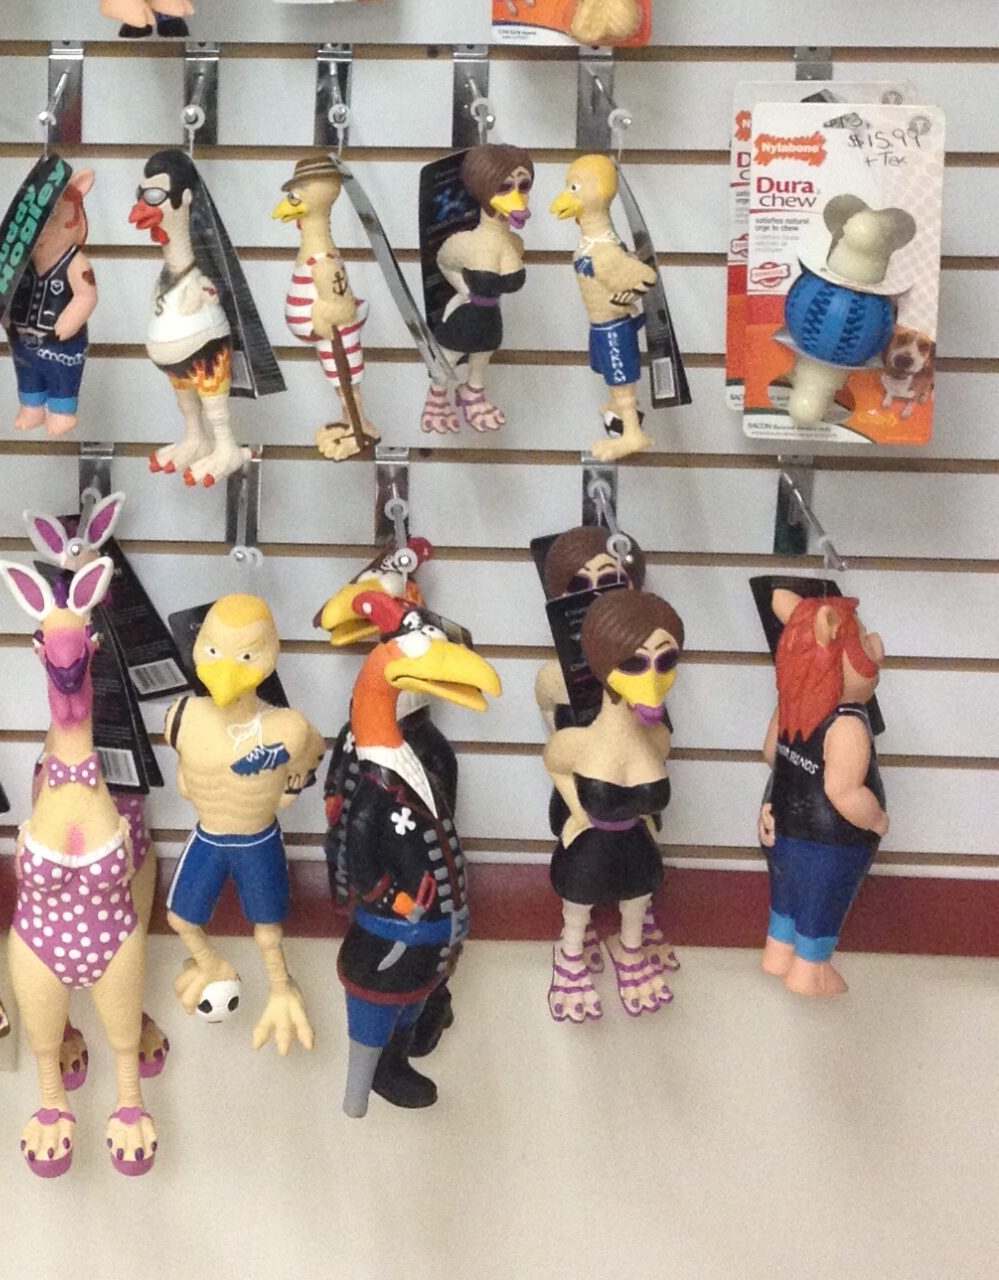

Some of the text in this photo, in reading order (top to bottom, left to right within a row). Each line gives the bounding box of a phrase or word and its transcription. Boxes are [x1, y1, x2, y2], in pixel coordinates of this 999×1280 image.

[761, 142, 820, 154] Nylabone
[756, 176, 815, 194] Dura
[759, 194, 817, 208] chew
